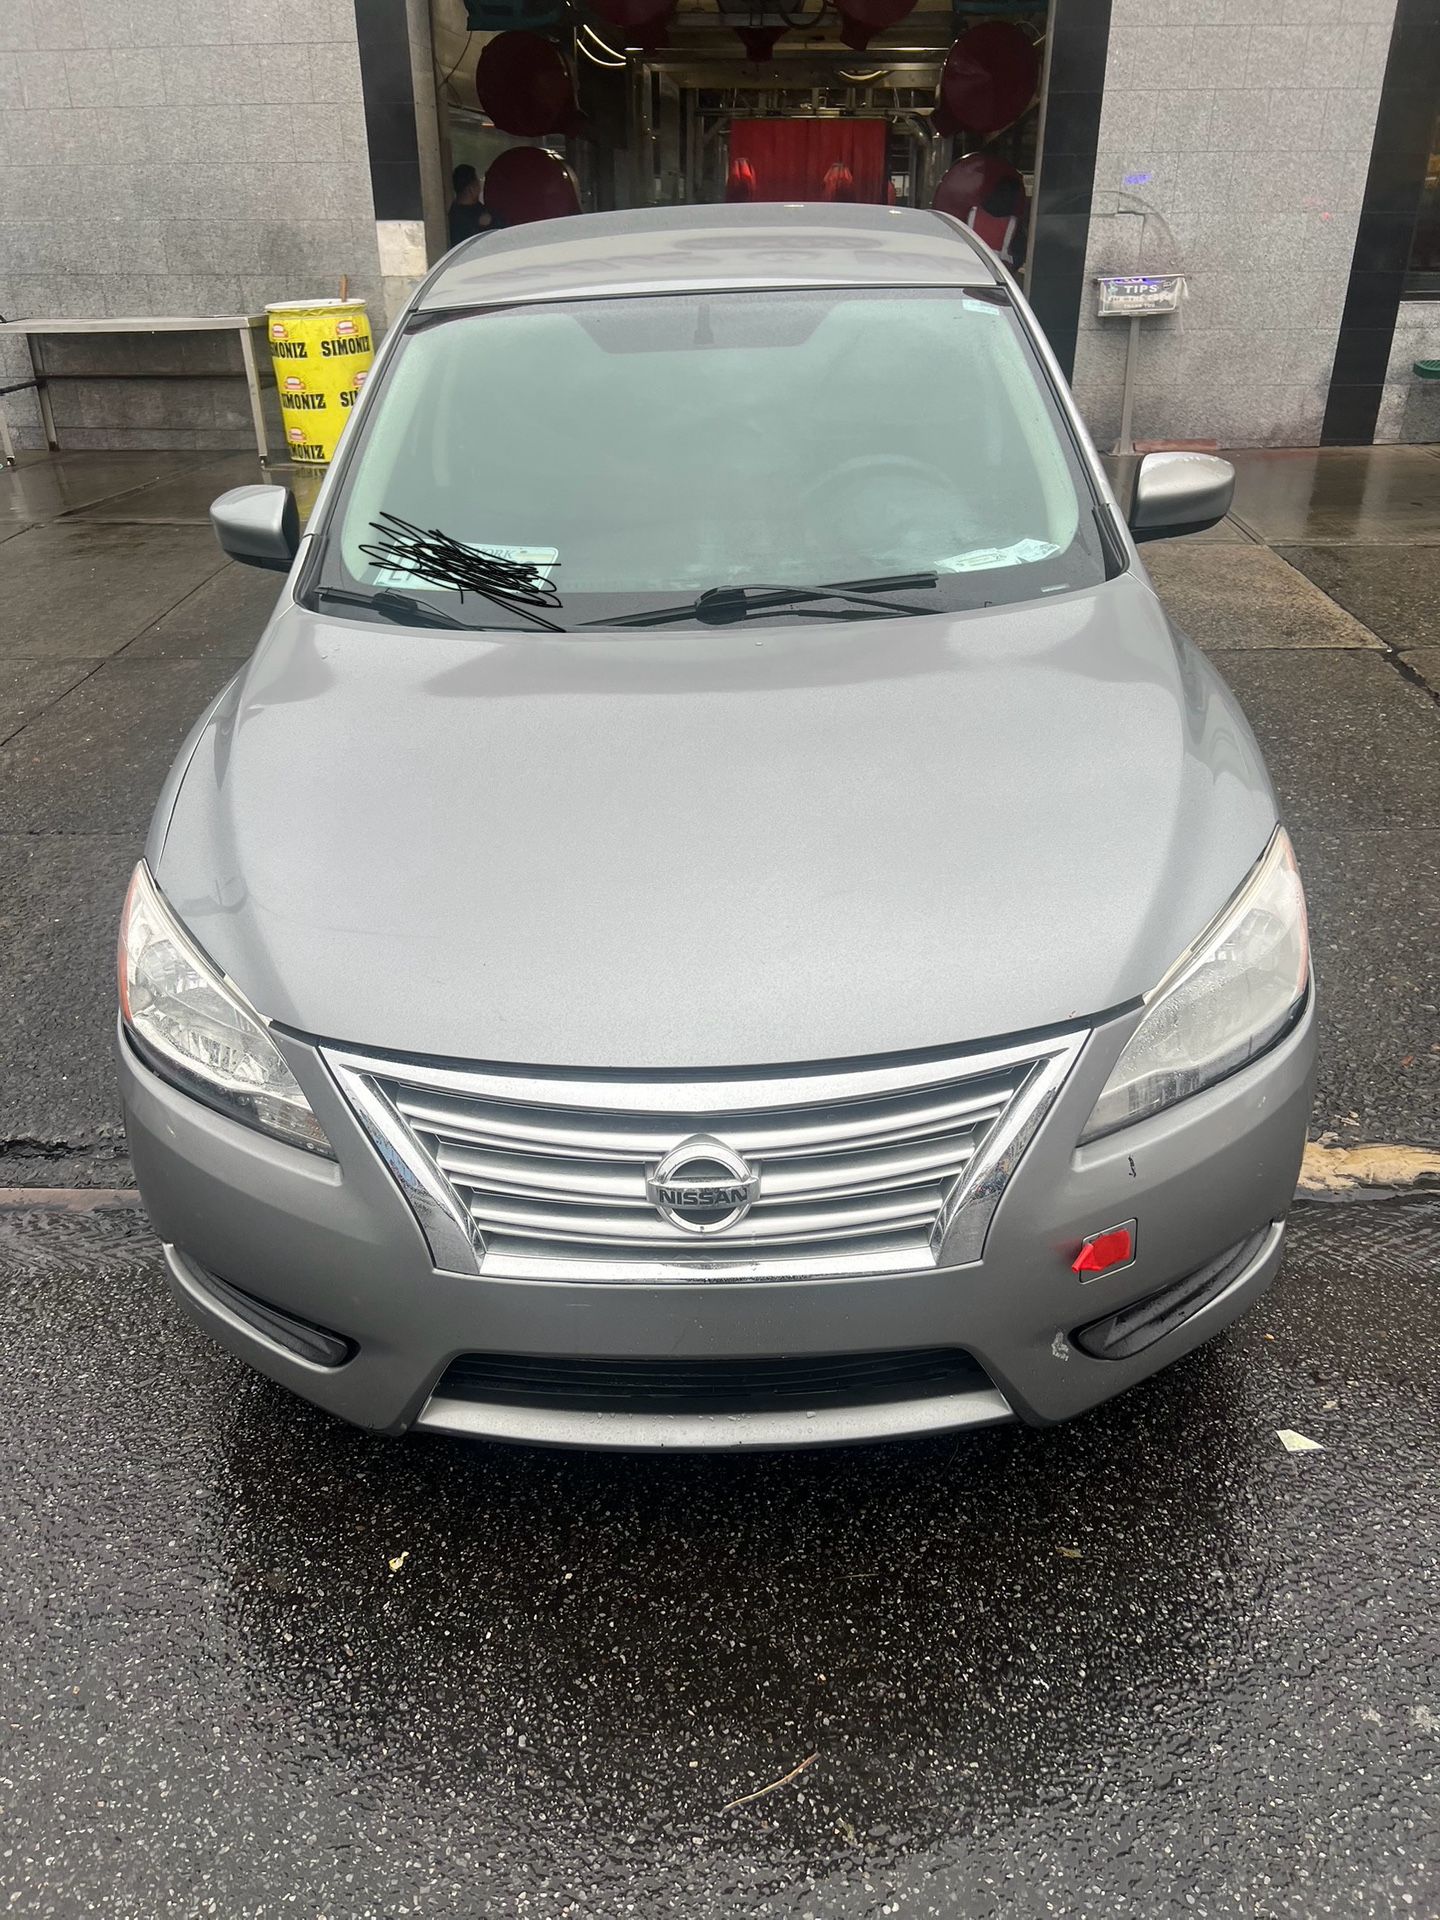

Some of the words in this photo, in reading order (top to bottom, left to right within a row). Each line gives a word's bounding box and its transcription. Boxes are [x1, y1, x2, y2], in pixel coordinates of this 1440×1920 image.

[1124, 284, 1158, 294] TIPS
[321, 336, 370, 357] SIMONIZ
[660, 1187, 748, 1206] NISSAN
